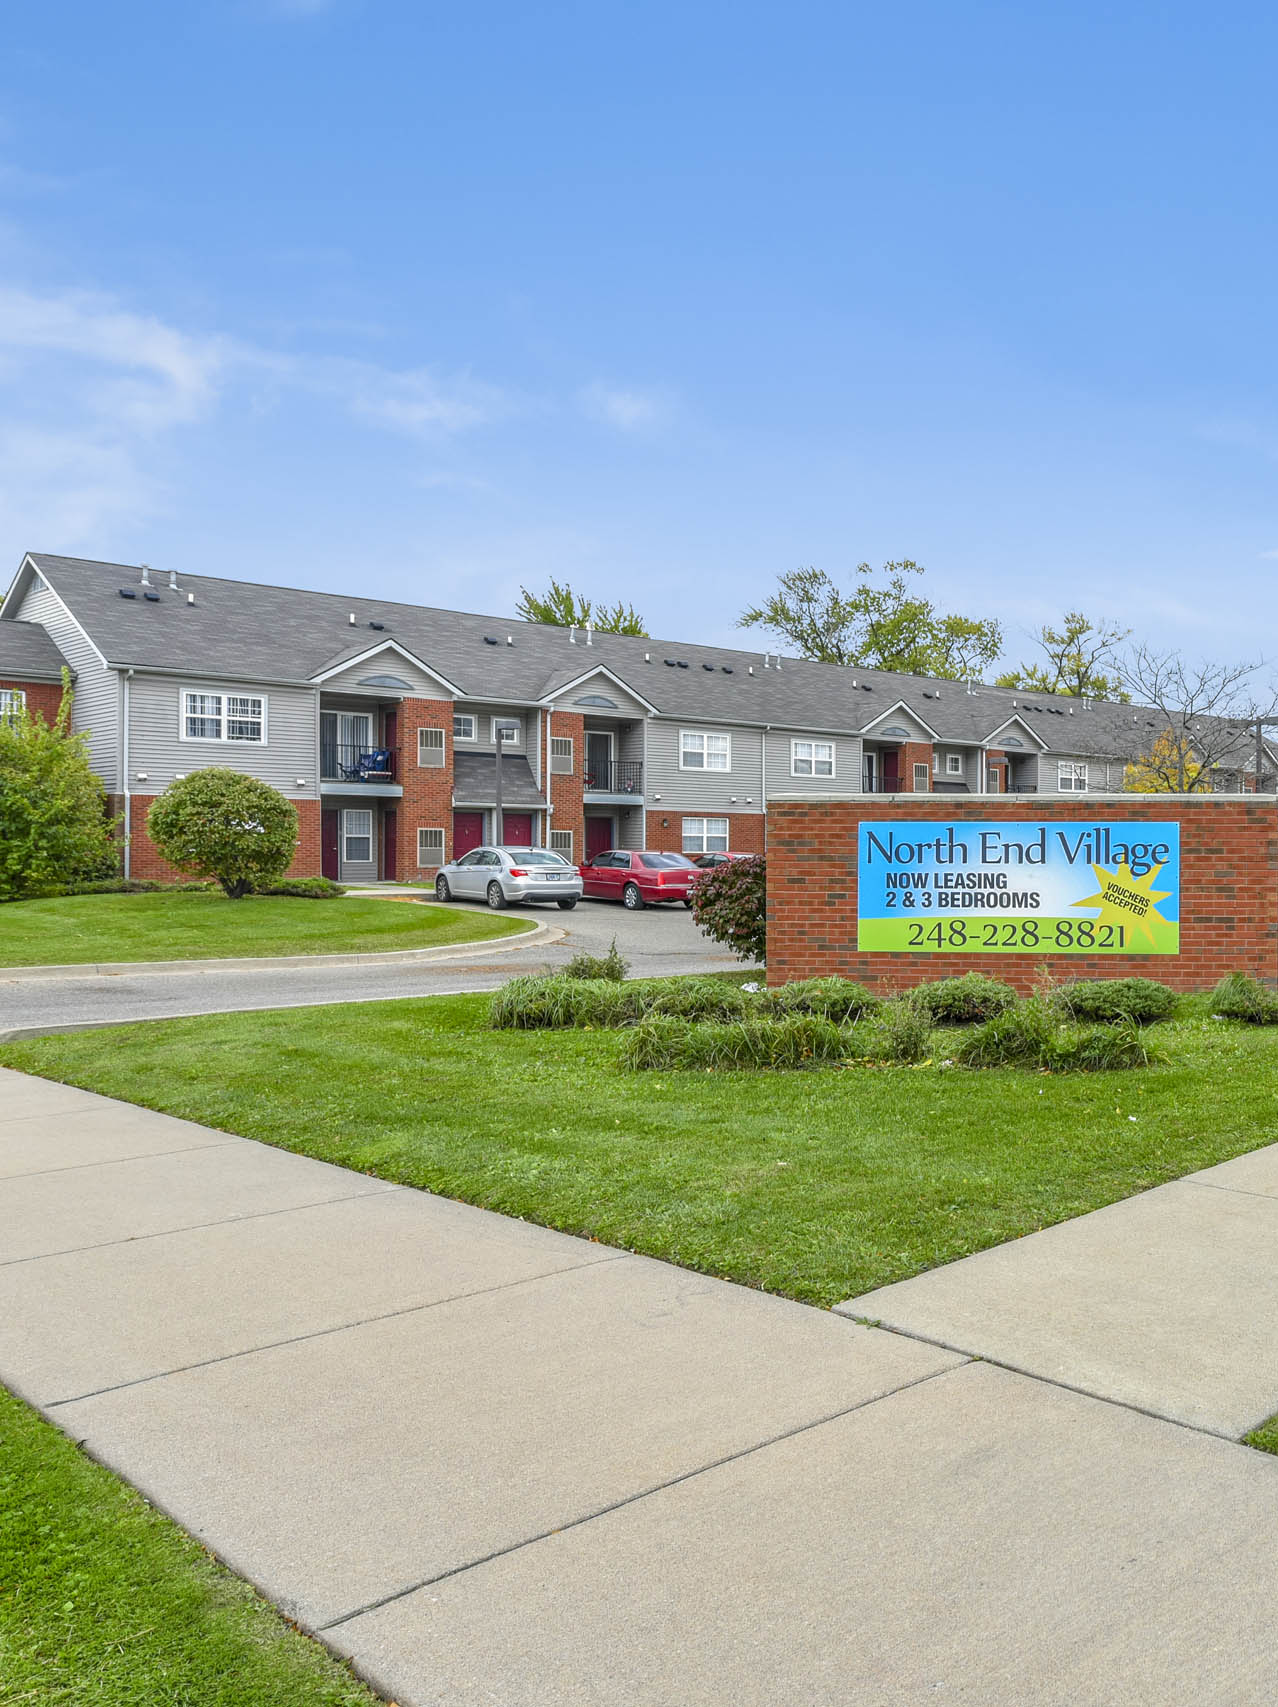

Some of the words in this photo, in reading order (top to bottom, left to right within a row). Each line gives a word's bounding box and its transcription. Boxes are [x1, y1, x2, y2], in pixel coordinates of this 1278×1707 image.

[867, 827, 968, 865] North
[978, 827, 1046, 865] End
[1056, 827, 1170, 877] Village
[886, 872, 930, 889] NOW
[934, 872, 1008, 889] LEASING
[886, 892, 897, 908] 2
[902, 892, 916, 908] &
[921, 892, 932, 908] 3
[938, 892, 1040, 909] BEDROOMS
[1102, 892, 1148, 918] ACCEPTED!
[1107, 881, 1151, 908] VOUCHERS
[908, 919, 1125, 948] 248-228-8821
